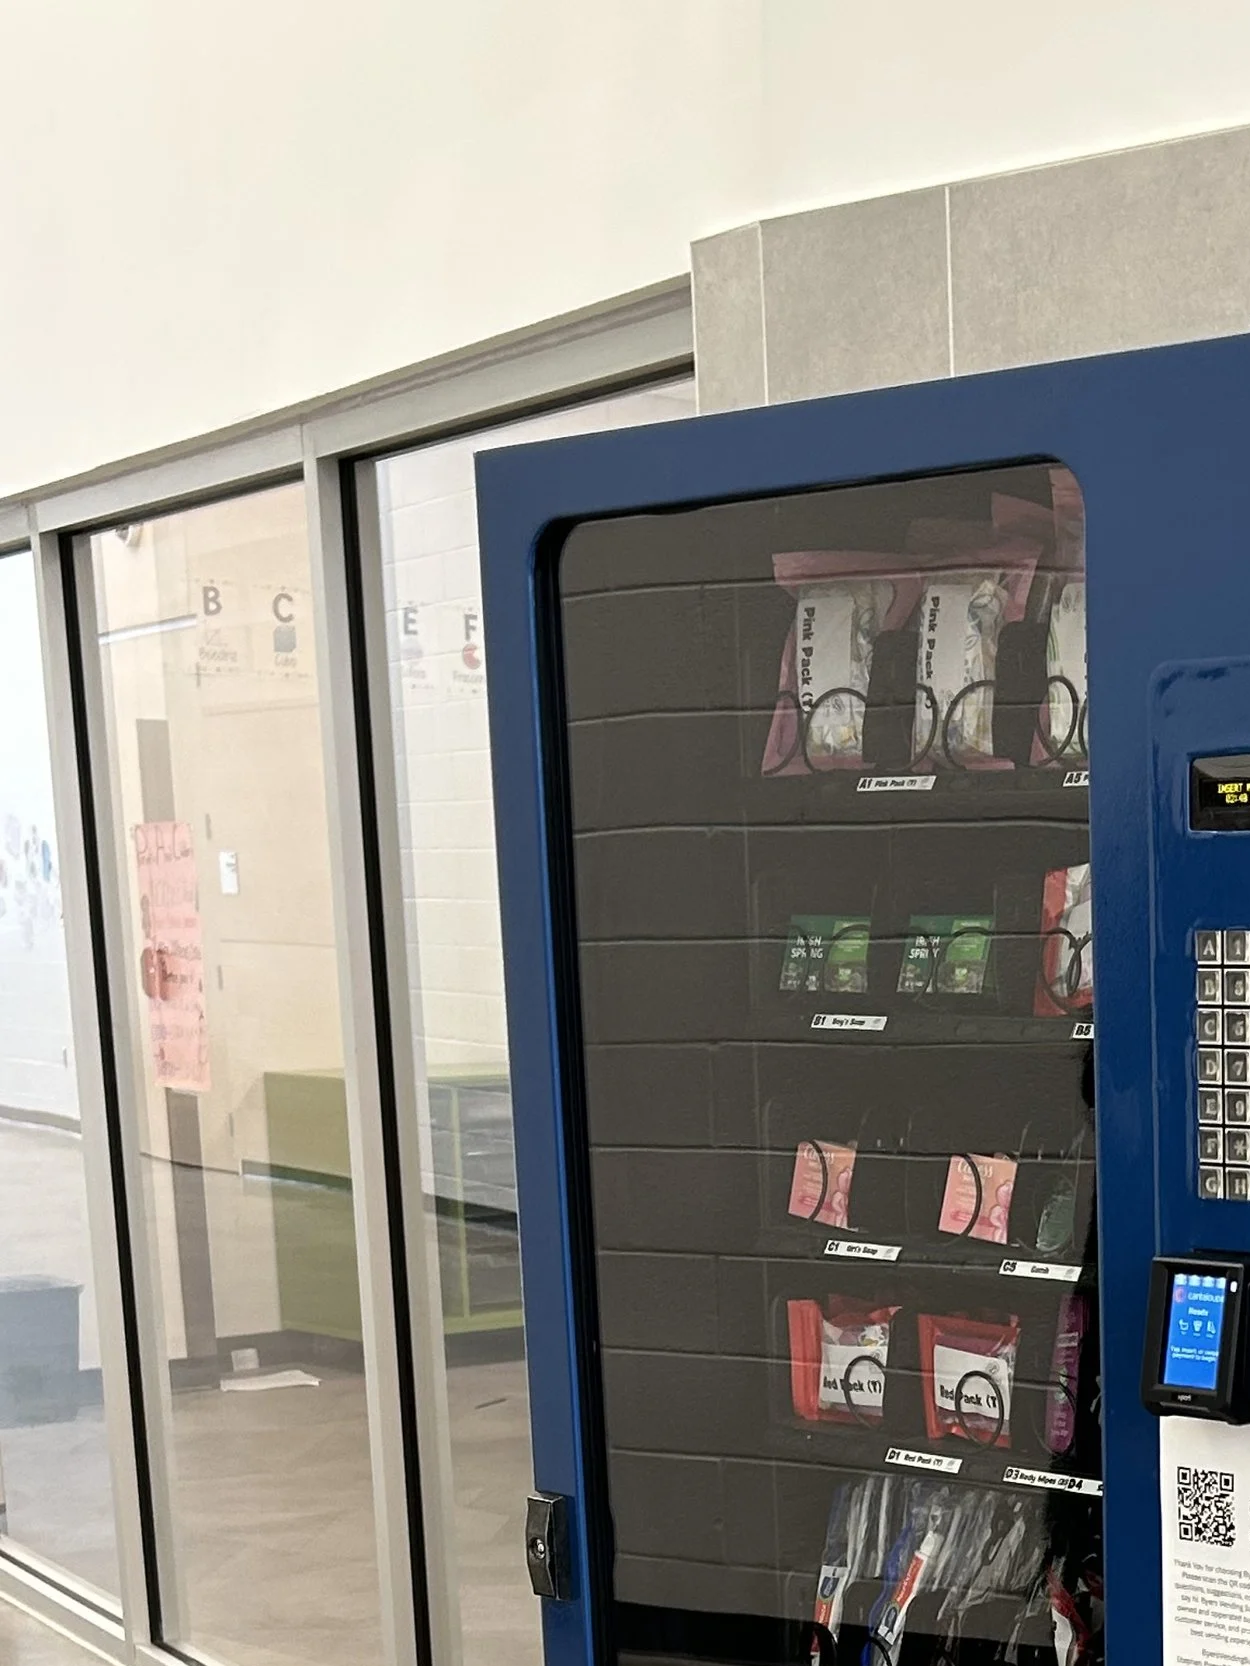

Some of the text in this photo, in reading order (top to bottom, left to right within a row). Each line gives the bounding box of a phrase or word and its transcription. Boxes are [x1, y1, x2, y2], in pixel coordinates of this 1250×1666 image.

[202, 585, 222, 616] B
[272, 592, 295, 623] C
[928, 595, 940, 632] Pink
[403, 607, 419, 636] E
[464, 613, 479, 642] F
[802, 606, 815, 641] Pink
[801, 646, 814, 686] Pack
[925, 638, 936, 679] Pack
[859, 778, 872, 789] A1
[1066, 772, 1082, 784] A5
[1217, 783, 1243, 793] INSERT
[1203, 940, 1215, 955] A
[1235, 941, 1240, 955] 1
[1205, 980, 1215, 995] B
[1075, 1025, 1092, 1036] B5
[1204, 1020, 1215, 1035] C
[1206, 1059, 1216, 1075] D
[1233, 1062, 1243, 1076] 7
[1206, 1099, 1216, 1114] E
[1207, 1138, 1216, 1153] F
[1205, 1177, 1246, 1194] G H
[828, 1241, 840, 1252] C1
[1003, 1261, 1049, 1274] C5 Comb
[888, 1450, 901, 1460] D1
[1006, 1469, 1019, 1480] D3
[1067, 1478, 1083, 1491] D4
